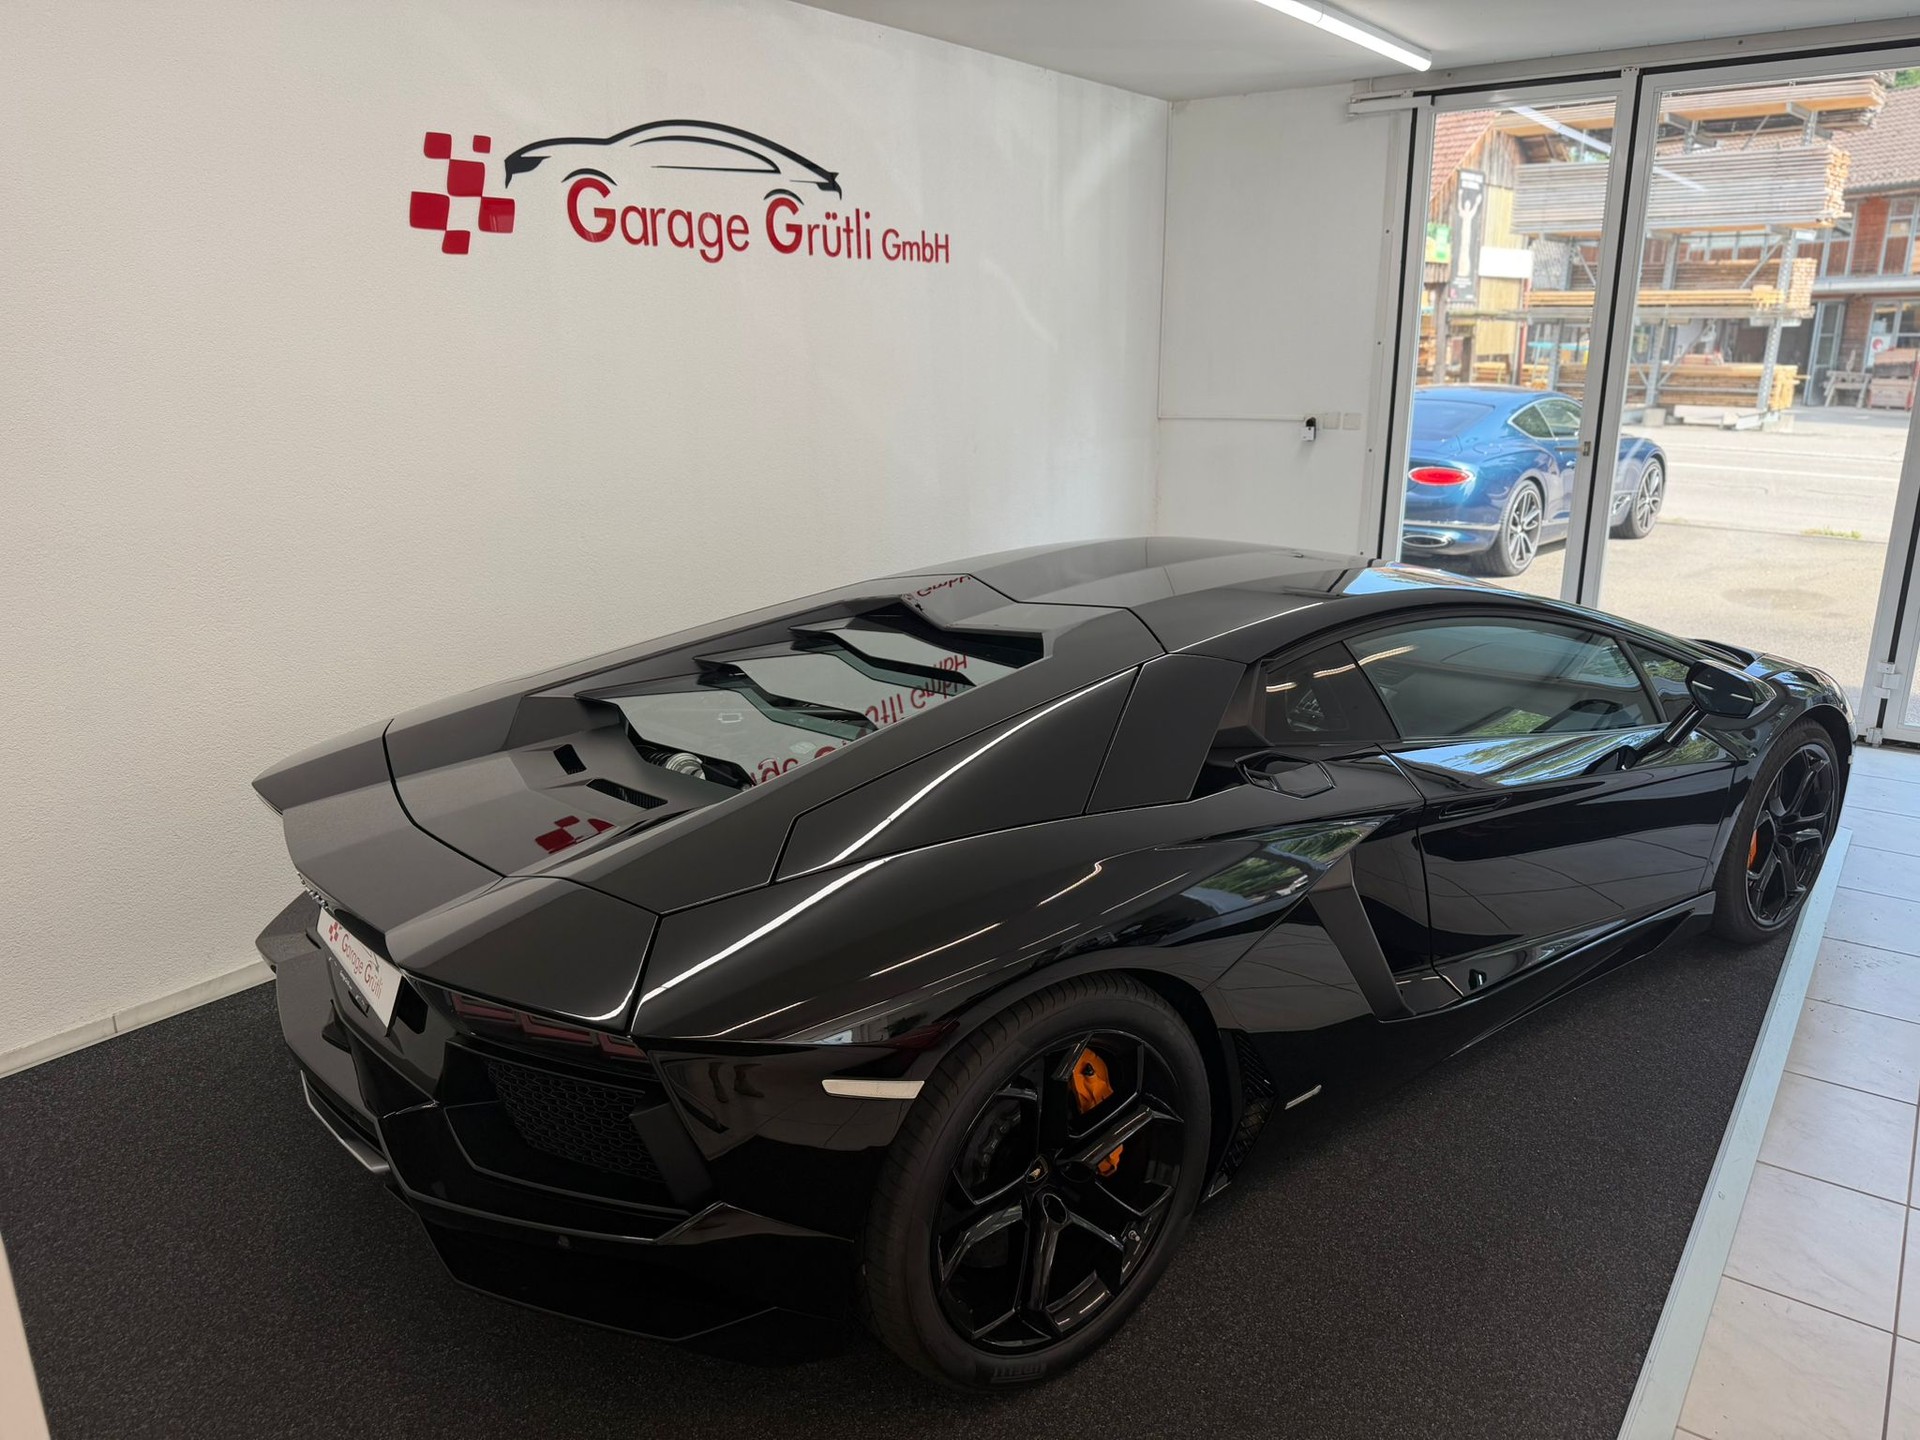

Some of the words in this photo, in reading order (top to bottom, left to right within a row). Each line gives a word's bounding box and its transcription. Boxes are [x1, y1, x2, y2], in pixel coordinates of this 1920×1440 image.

[567, 177, 751, 264] Garage
[765, 196, 873, 260] Grütli
[881, 228, 950, 264] GmbH
[341, 933, 364, 975] Garage
